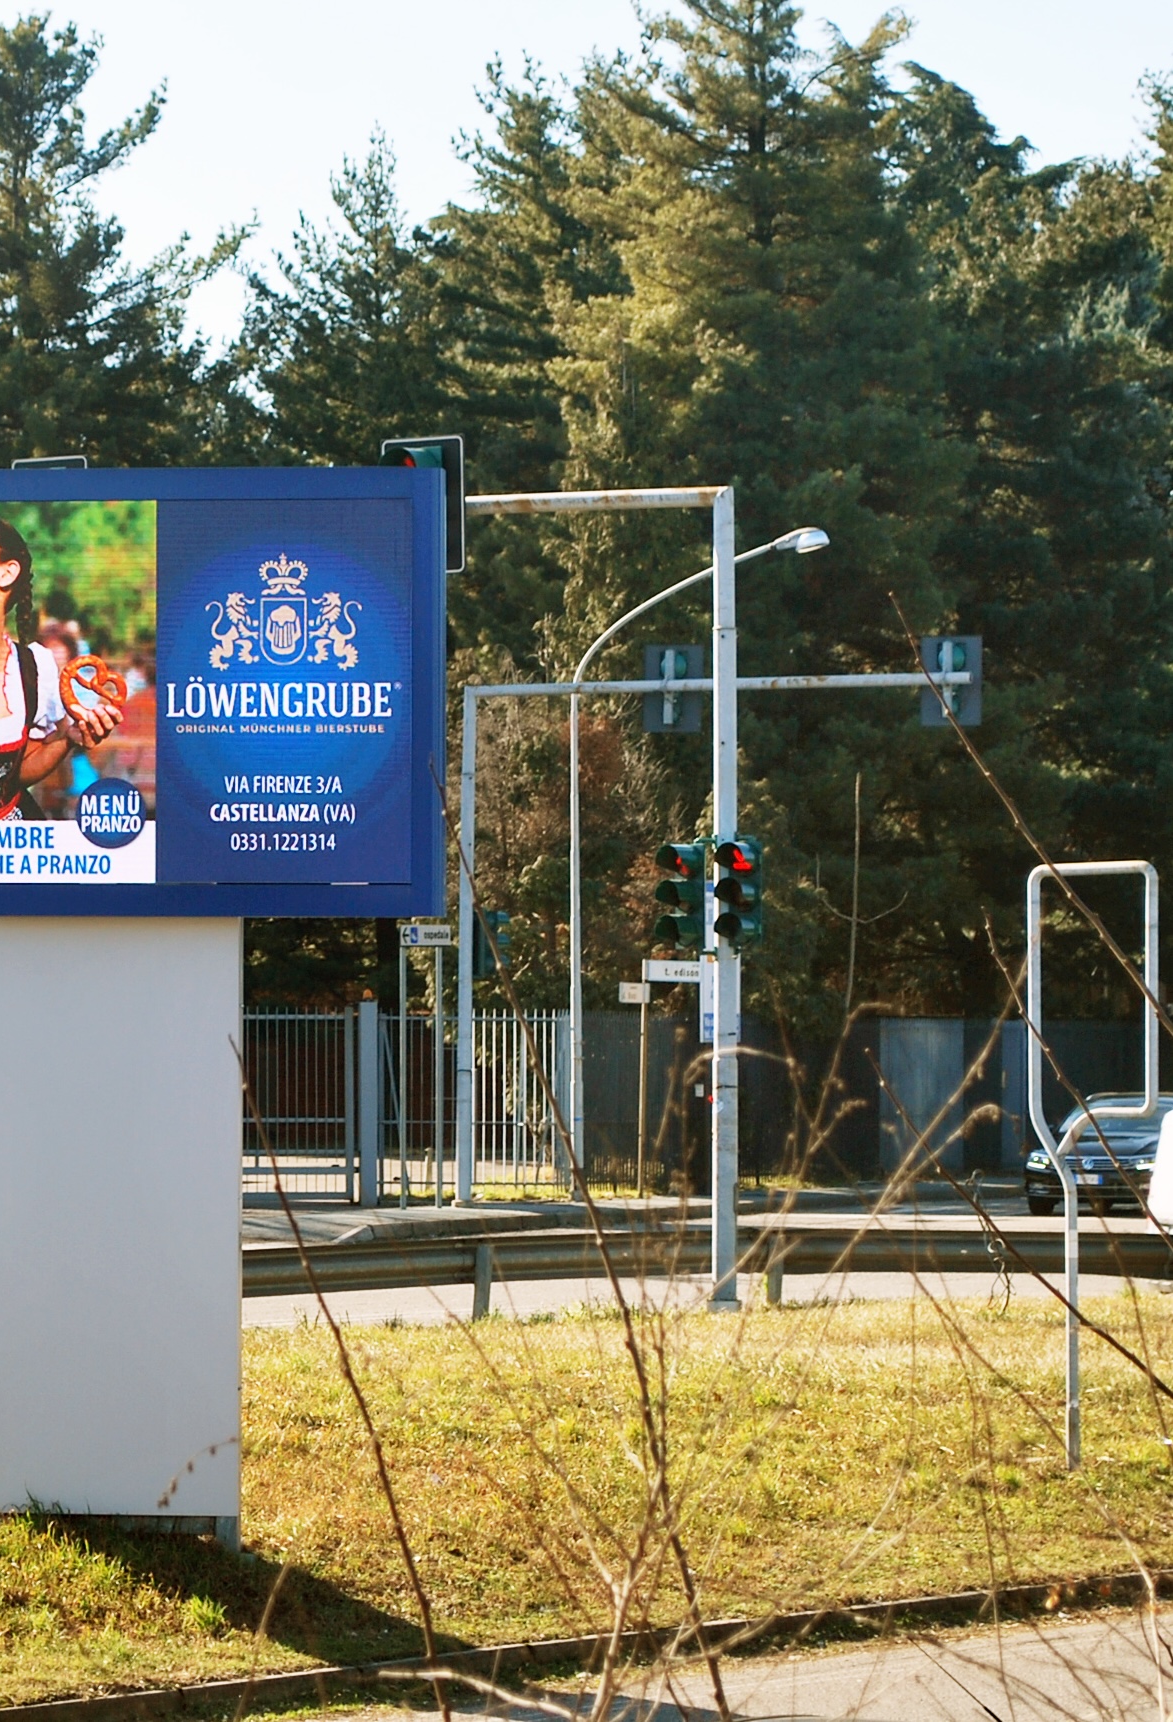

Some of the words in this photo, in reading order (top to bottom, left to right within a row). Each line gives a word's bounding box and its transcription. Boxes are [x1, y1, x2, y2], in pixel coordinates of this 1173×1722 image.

[175, 723, 236, 734] ORIGINAL
[239, 721, 312, 734] MÜNCHNER
[315, 723, 386, 734] BIERSTUBE
[224, 776, 250, 793] VIA
[253, 776, 312, 794] FIRENZE
[315, 775, 343, 794] 3/A
[80, 791, 140, 816] MENÜ
[209, 803, 320, 823] CASTELLANZA
[322, 802, 356, 825] (VA)
[80, 815, 142, 833] PRANZO
[230, 833, 336, 851] 0331.1221314
[20, 855, 32, 874] A
[37, 854, 112, 875] PRANZO
[674, 968, 700, 977] edison
